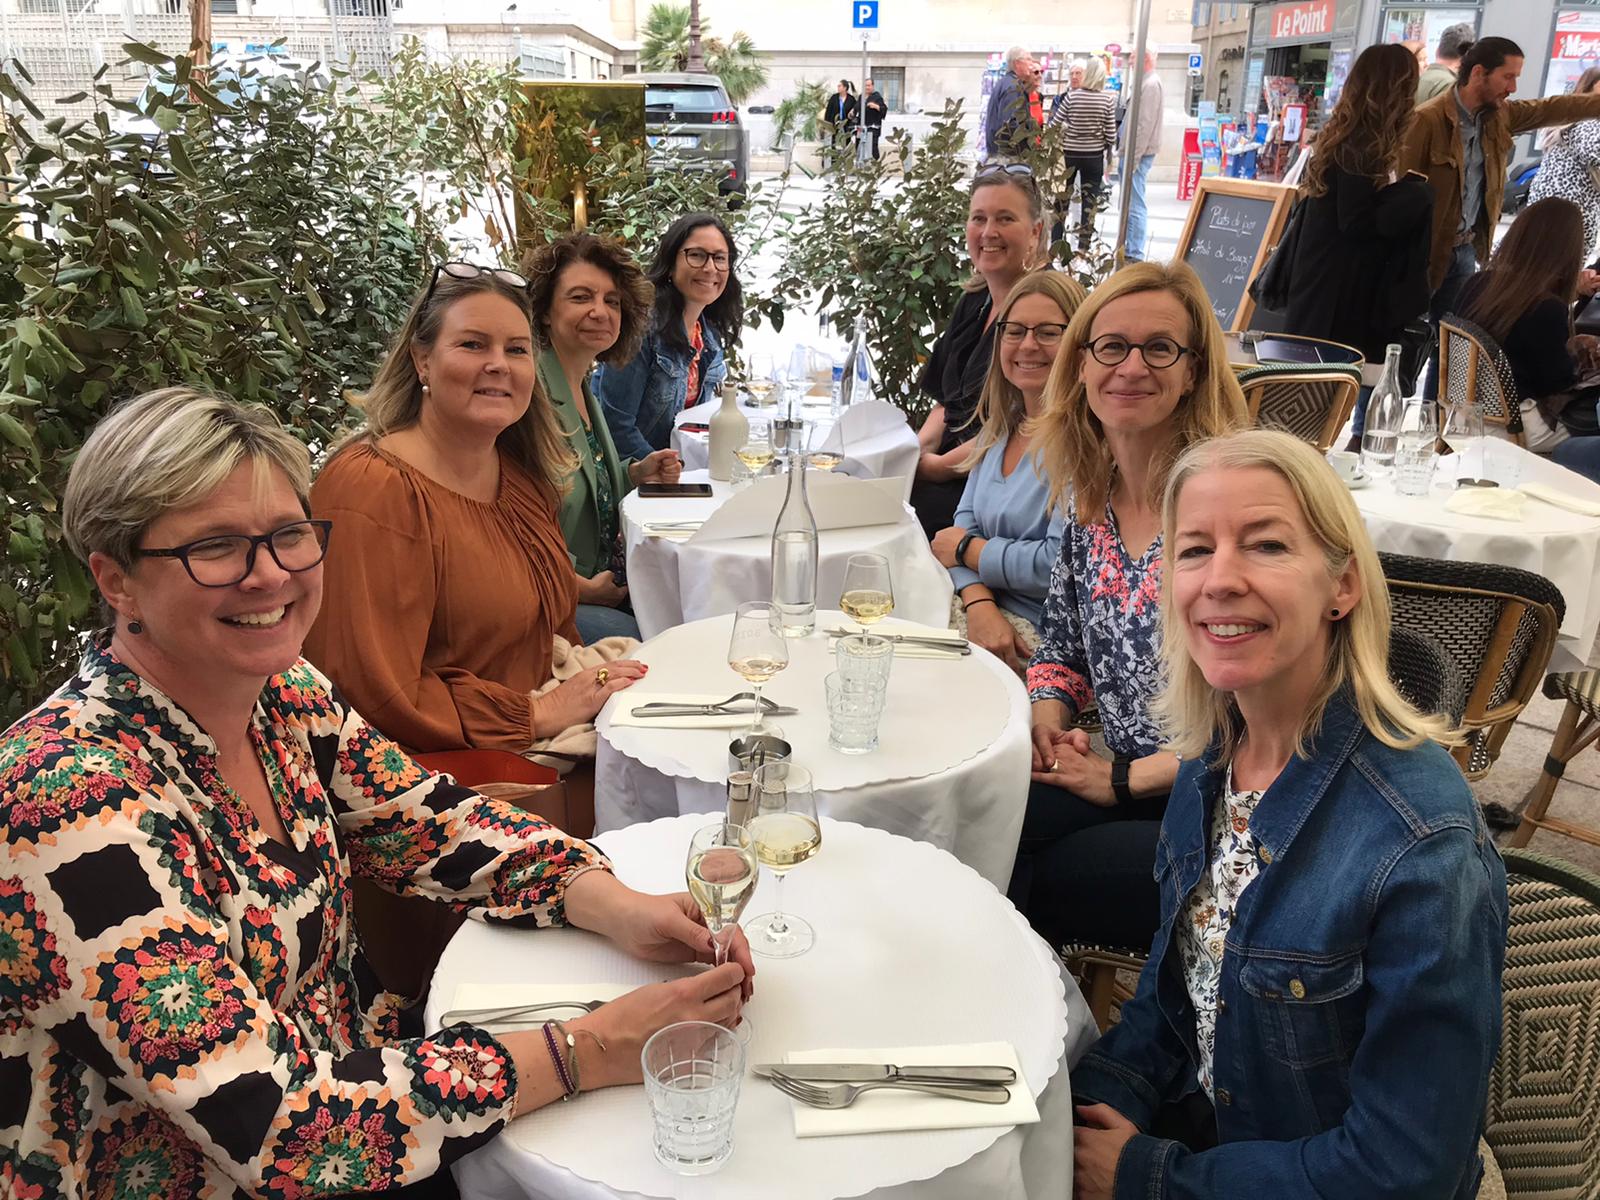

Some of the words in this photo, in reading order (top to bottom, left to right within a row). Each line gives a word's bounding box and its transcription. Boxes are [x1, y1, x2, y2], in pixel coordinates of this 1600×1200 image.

[859, 5, 872, 24] P
[1276, 12, 1291, 37] Le
[1291, 4, 1327, 35] Point
[1187, 162, 1198, 188] Point
